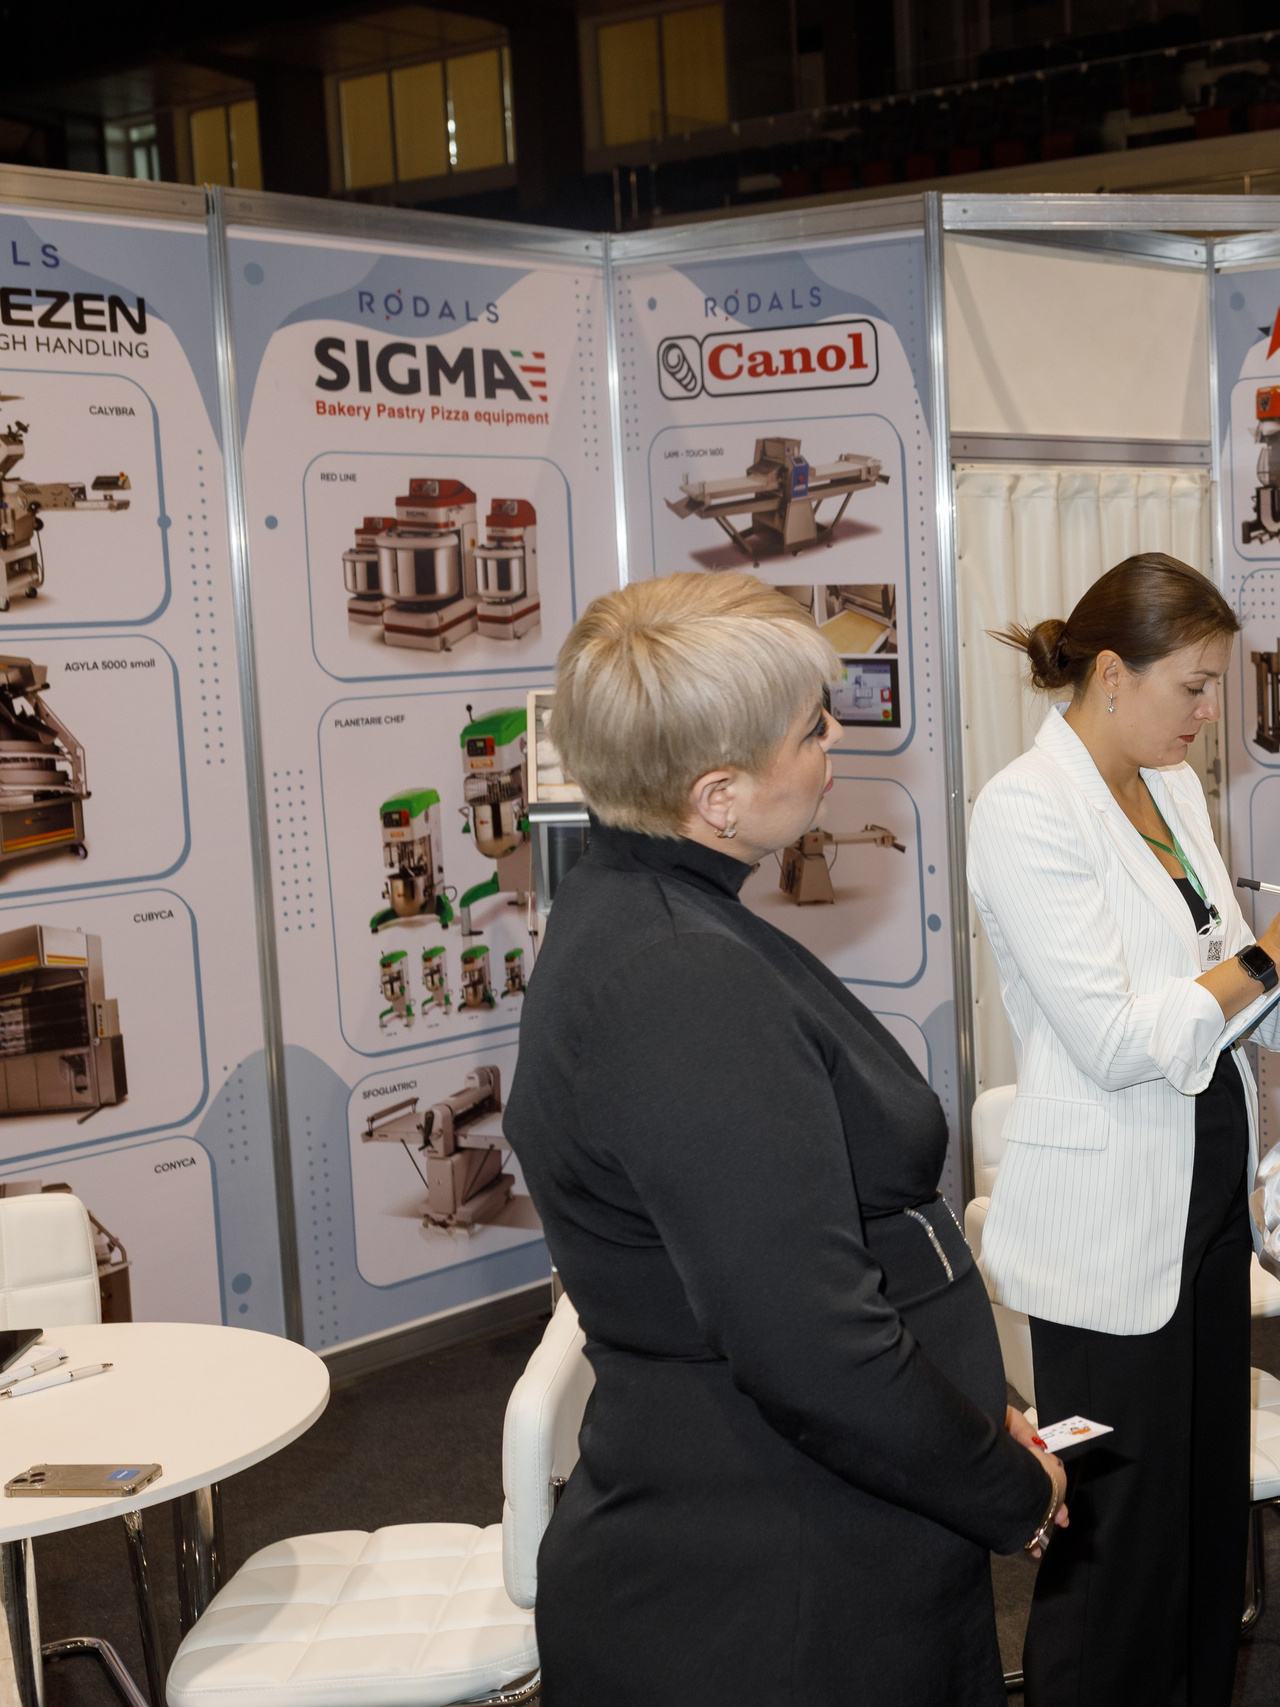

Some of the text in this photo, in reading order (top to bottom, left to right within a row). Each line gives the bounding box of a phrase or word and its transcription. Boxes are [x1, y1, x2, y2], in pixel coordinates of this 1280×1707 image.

[36, 336, 149, 358] HANDLING
[707, 332, 869, 381] Canol
[314, 336, 534, 402] SIGMA
[89, 405, 136, 417] CALYBRA
[315, 400, 550, 427] Bakery Pastry Pizza equipment
[685, 448, 708, 458] TOUCH
[320, 472, 357, 483] RED LINE
[64, 658, 156, 672] AGYLA 5000 small
[334, 714, 406, 728] PLANETARIE CHEF
[133, 909, 174, 923] CUBYCA
[362, 1080, 418, 1100] SFOGLIATRICI
[154, 1157, 197, 1174] CONYCA
